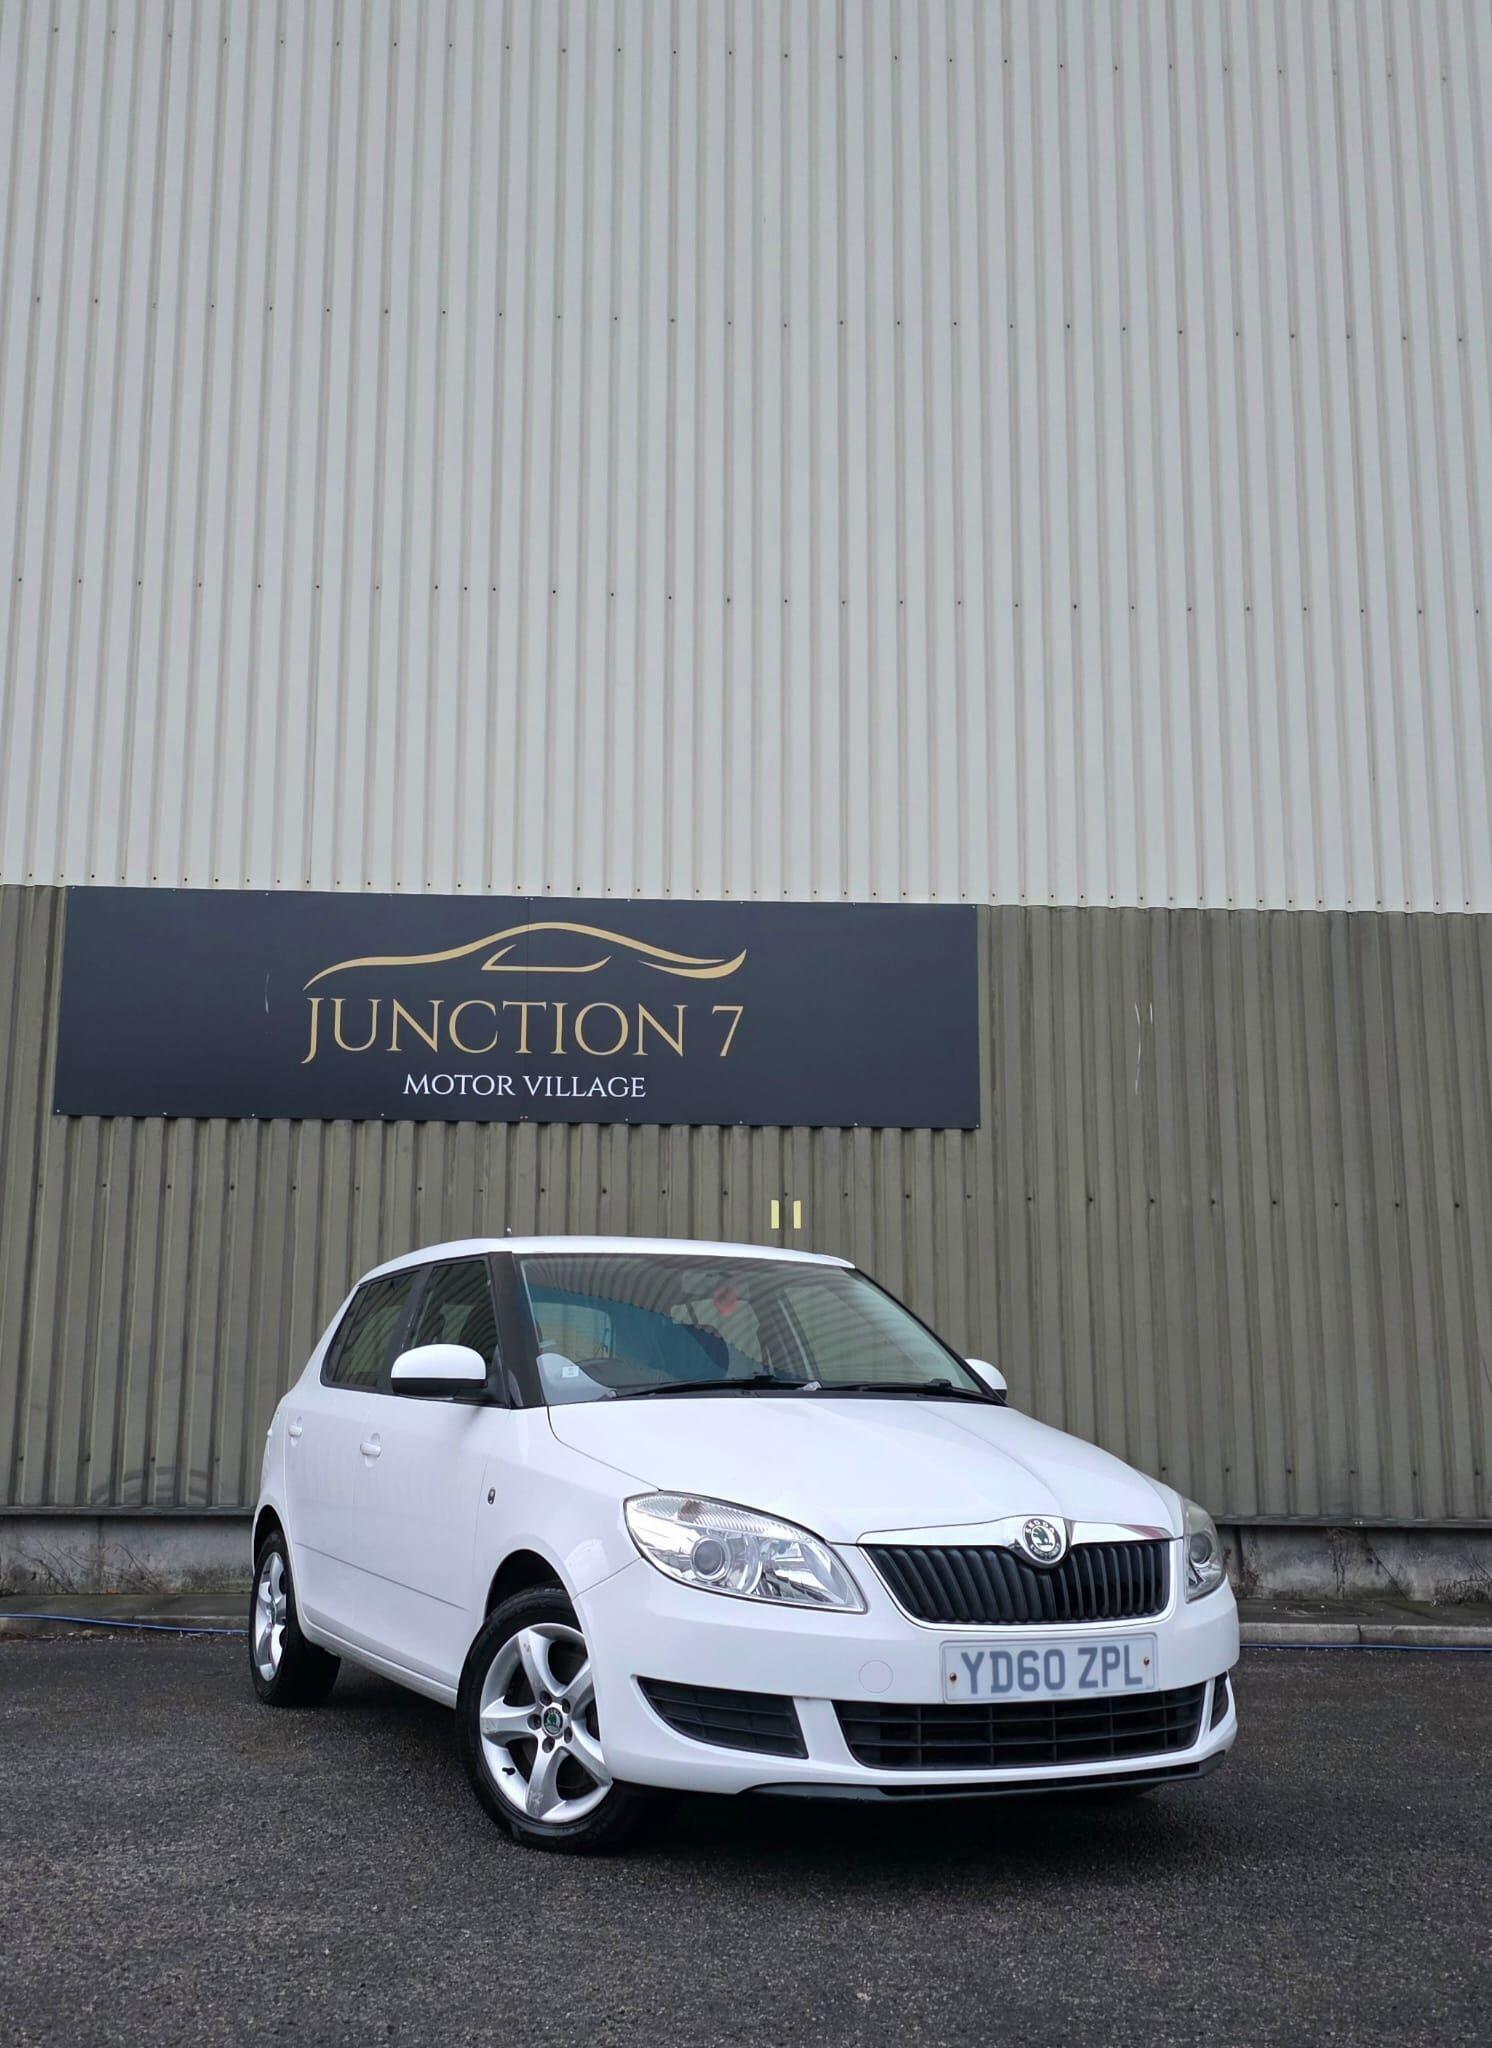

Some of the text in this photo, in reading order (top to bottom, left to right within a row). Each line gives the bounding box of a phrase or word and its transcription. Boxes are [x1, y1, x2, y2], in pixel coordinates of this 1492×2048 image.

[301, 997, 744, 1064] JUNCTION 7
[402, 1073, 647, 1098] MOTOR VILLAGE
[961, 1645, 1143, 1695] YD60 ZPL
